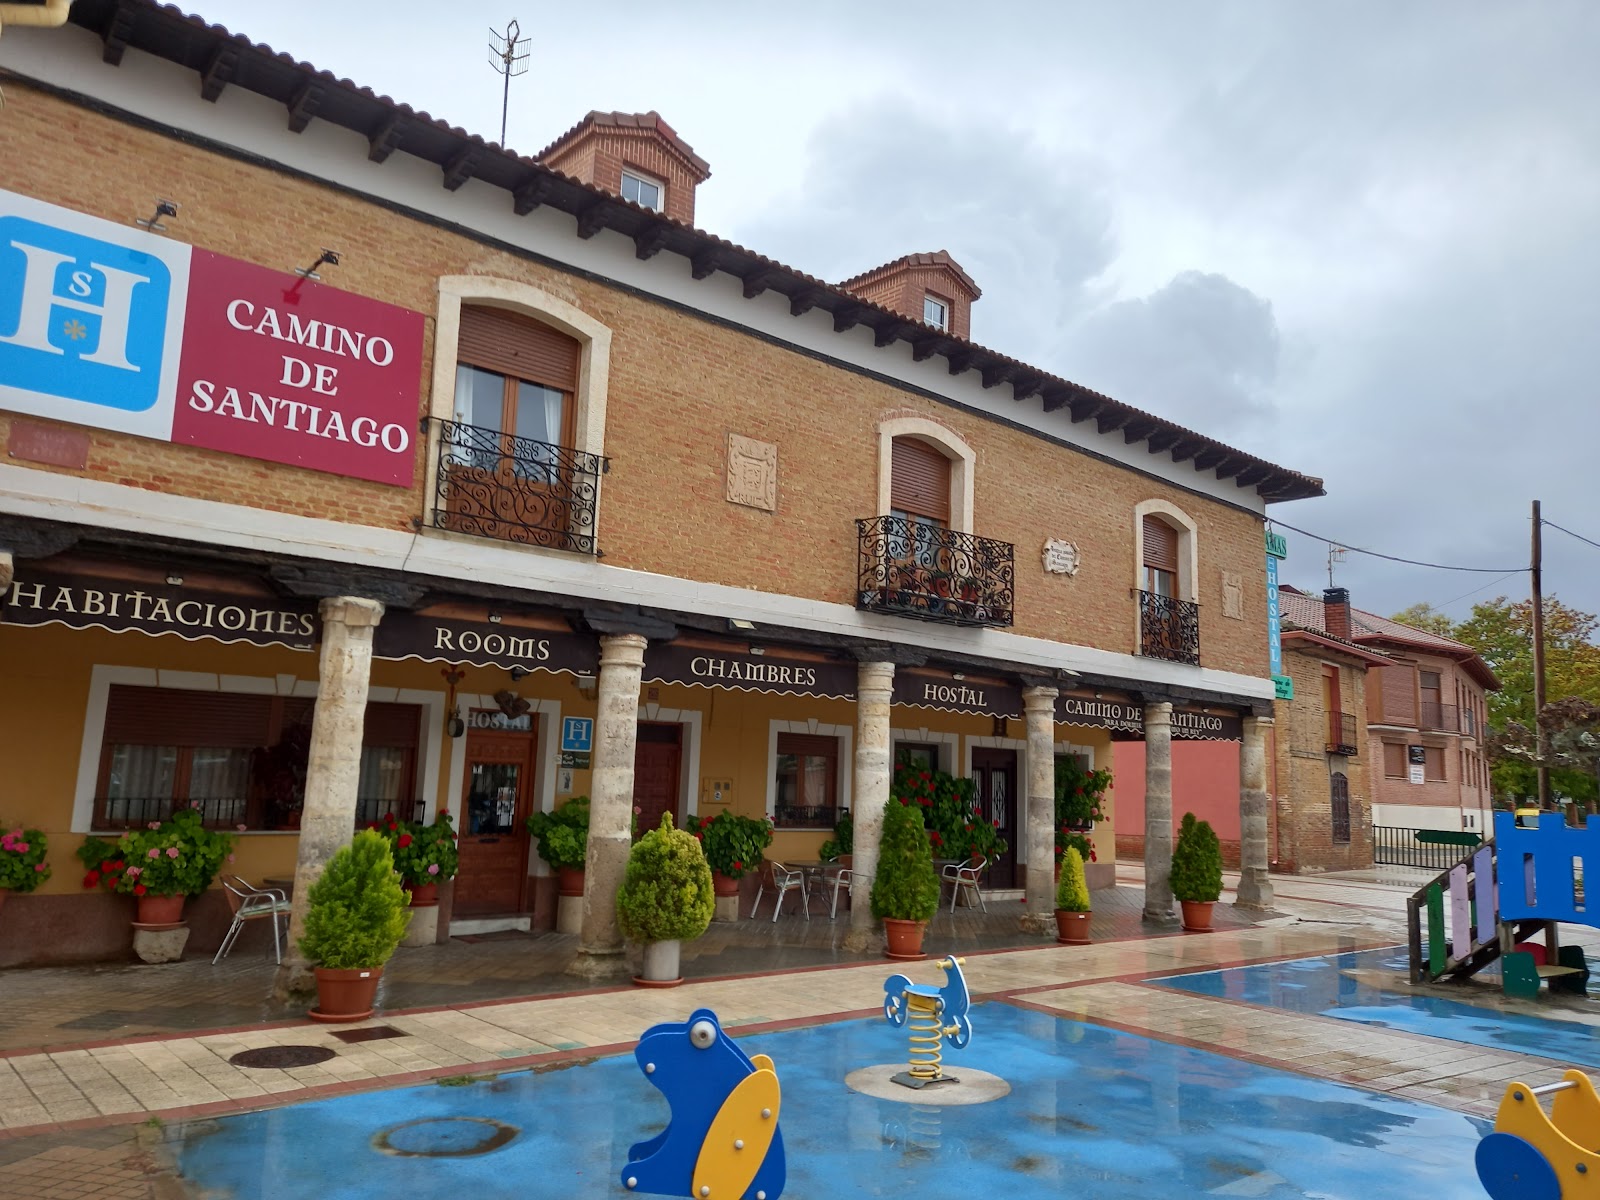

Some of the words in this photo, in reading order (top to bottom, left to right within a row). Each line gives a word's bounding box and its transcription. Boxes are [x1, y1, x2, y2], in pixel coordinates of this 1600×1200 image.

[226, 299, 394, 367] CAMINO
[279, 356, 338, 396] DE
[188, 380, 409, 453] SANTIAGO
[8, 580, 315, 636] HABITACIONES
[1267, 571, 1279, 663] HOSTAL
[433, 627, 551, 660] ROOMS
[690, 656, 817, 687] CHAMBRES
[924, 683, 988, 708] HOSTAL
[566, 720, 590, 741] H
[1065, 699, 1121, 719] CAMINO
[1126, 706, 1142, 721] DE
[1170, 712, 1223, 731] ANTIAGO
